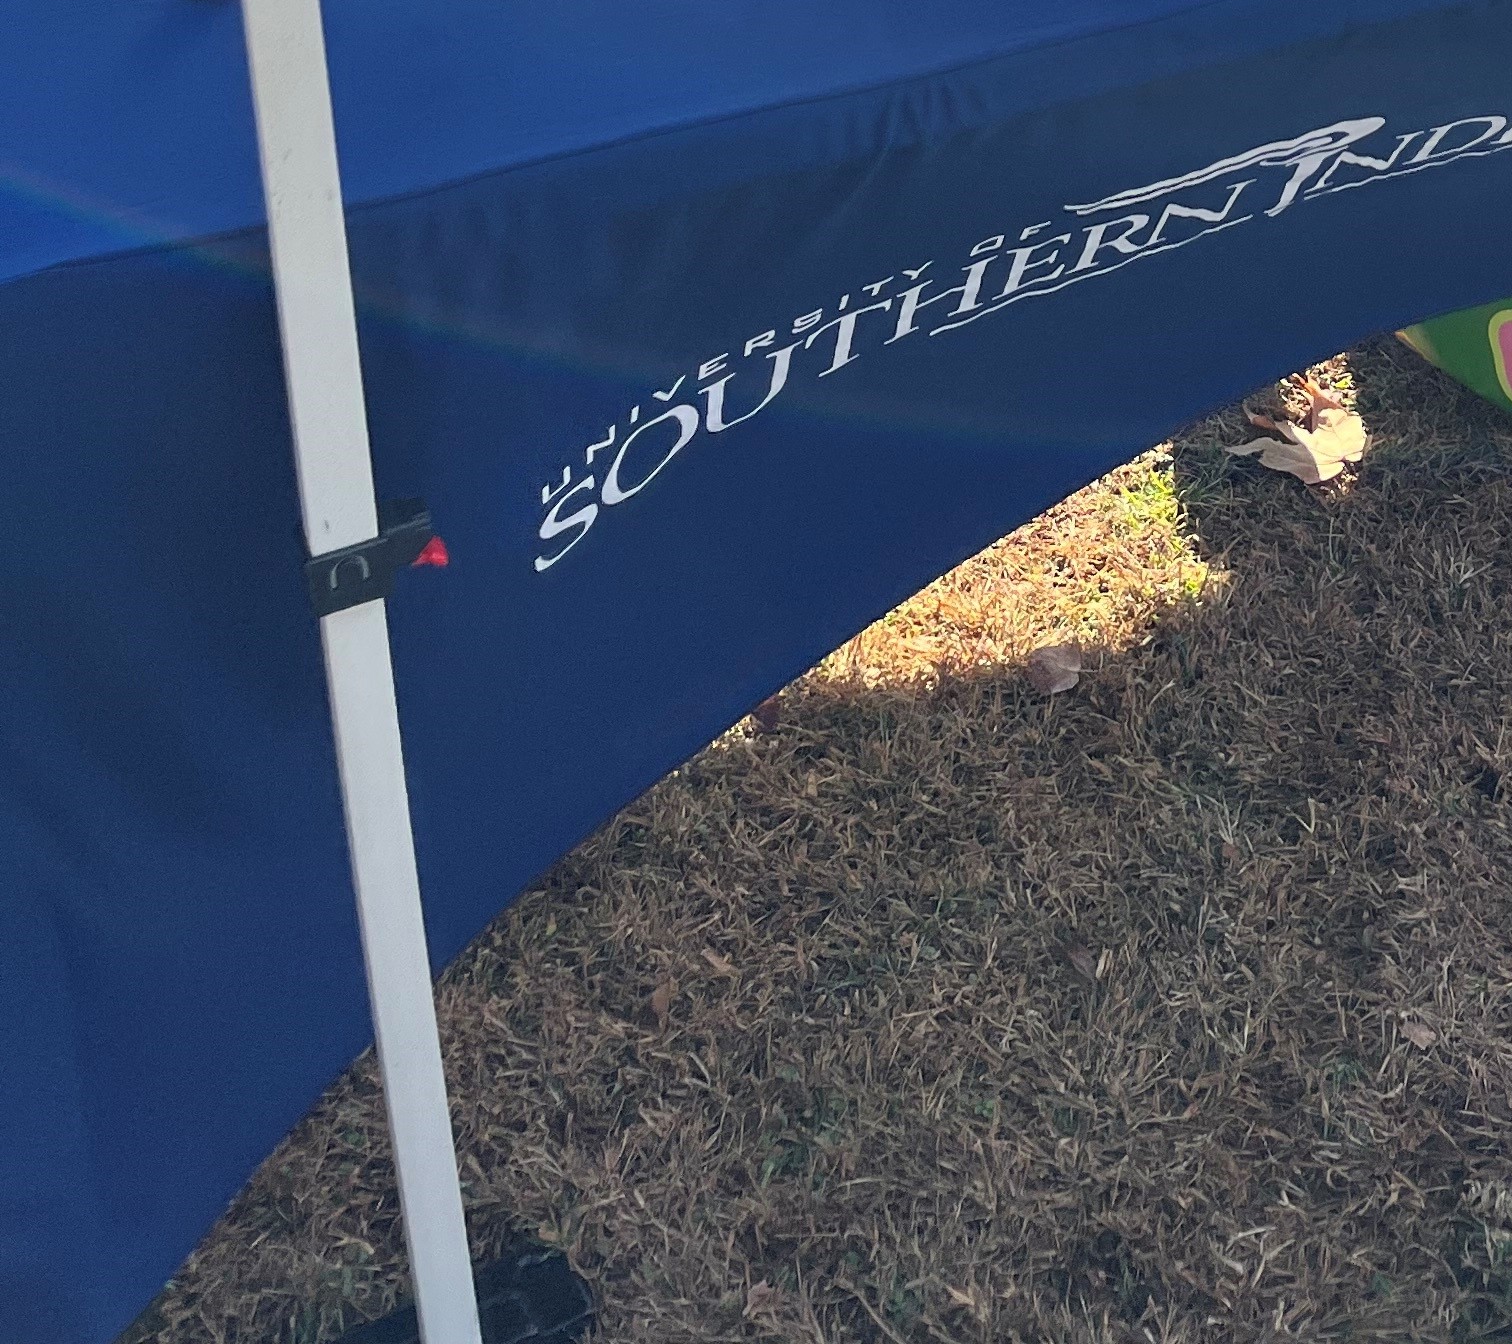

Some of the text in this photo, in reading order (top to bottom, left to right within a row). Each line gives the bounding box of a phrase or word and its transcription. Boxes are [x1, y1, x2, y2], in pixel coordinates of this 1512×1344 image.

[533, 179, 1258, 572] SOUTHERN
[541, 221, 1052, 505] UNIVERSITY OF
